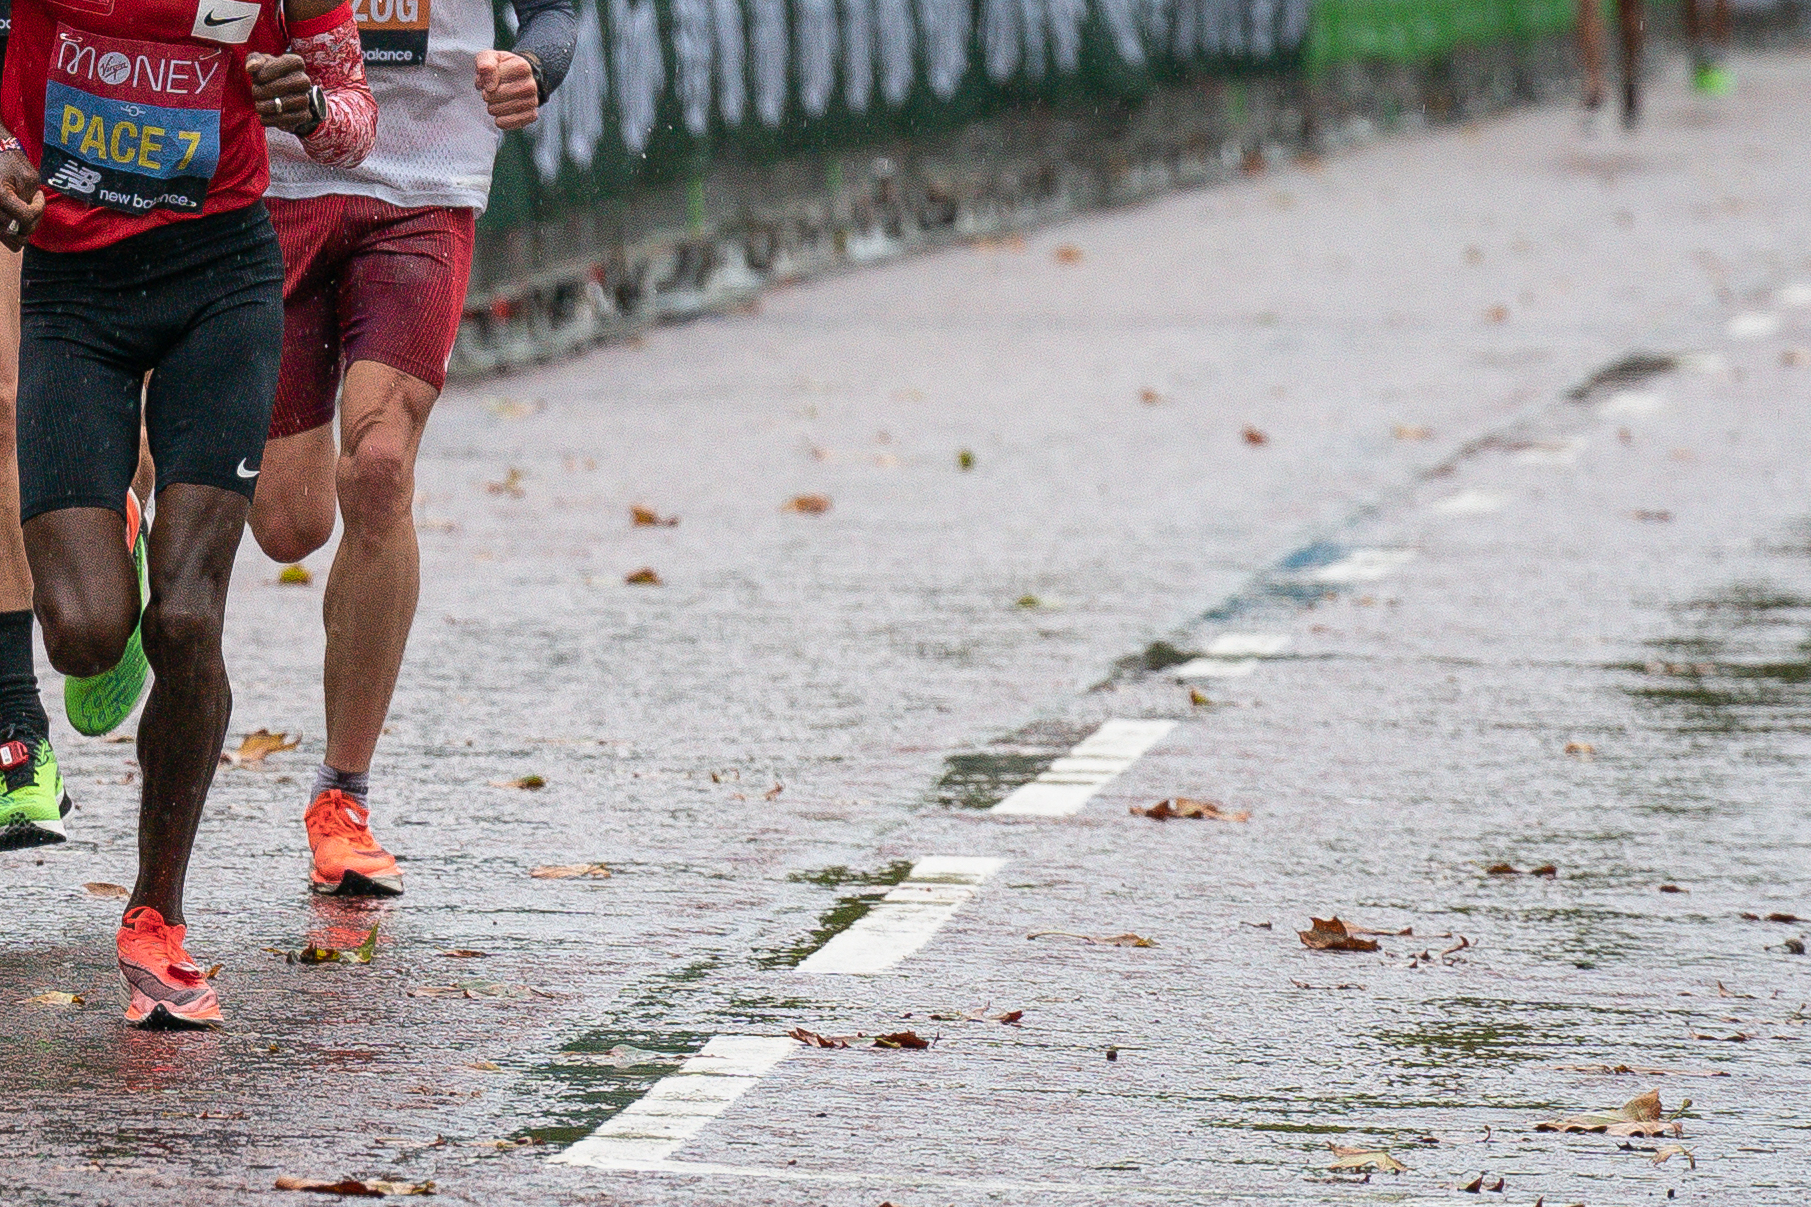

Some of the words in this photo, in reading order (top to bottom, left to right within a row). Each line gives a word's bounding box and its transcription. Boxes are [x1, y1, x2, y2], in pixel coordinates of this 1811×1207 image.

[60, 103, 166, 171] PACE
[177, 130, 201, 171] 7
[99, 189, 130, 204] new
